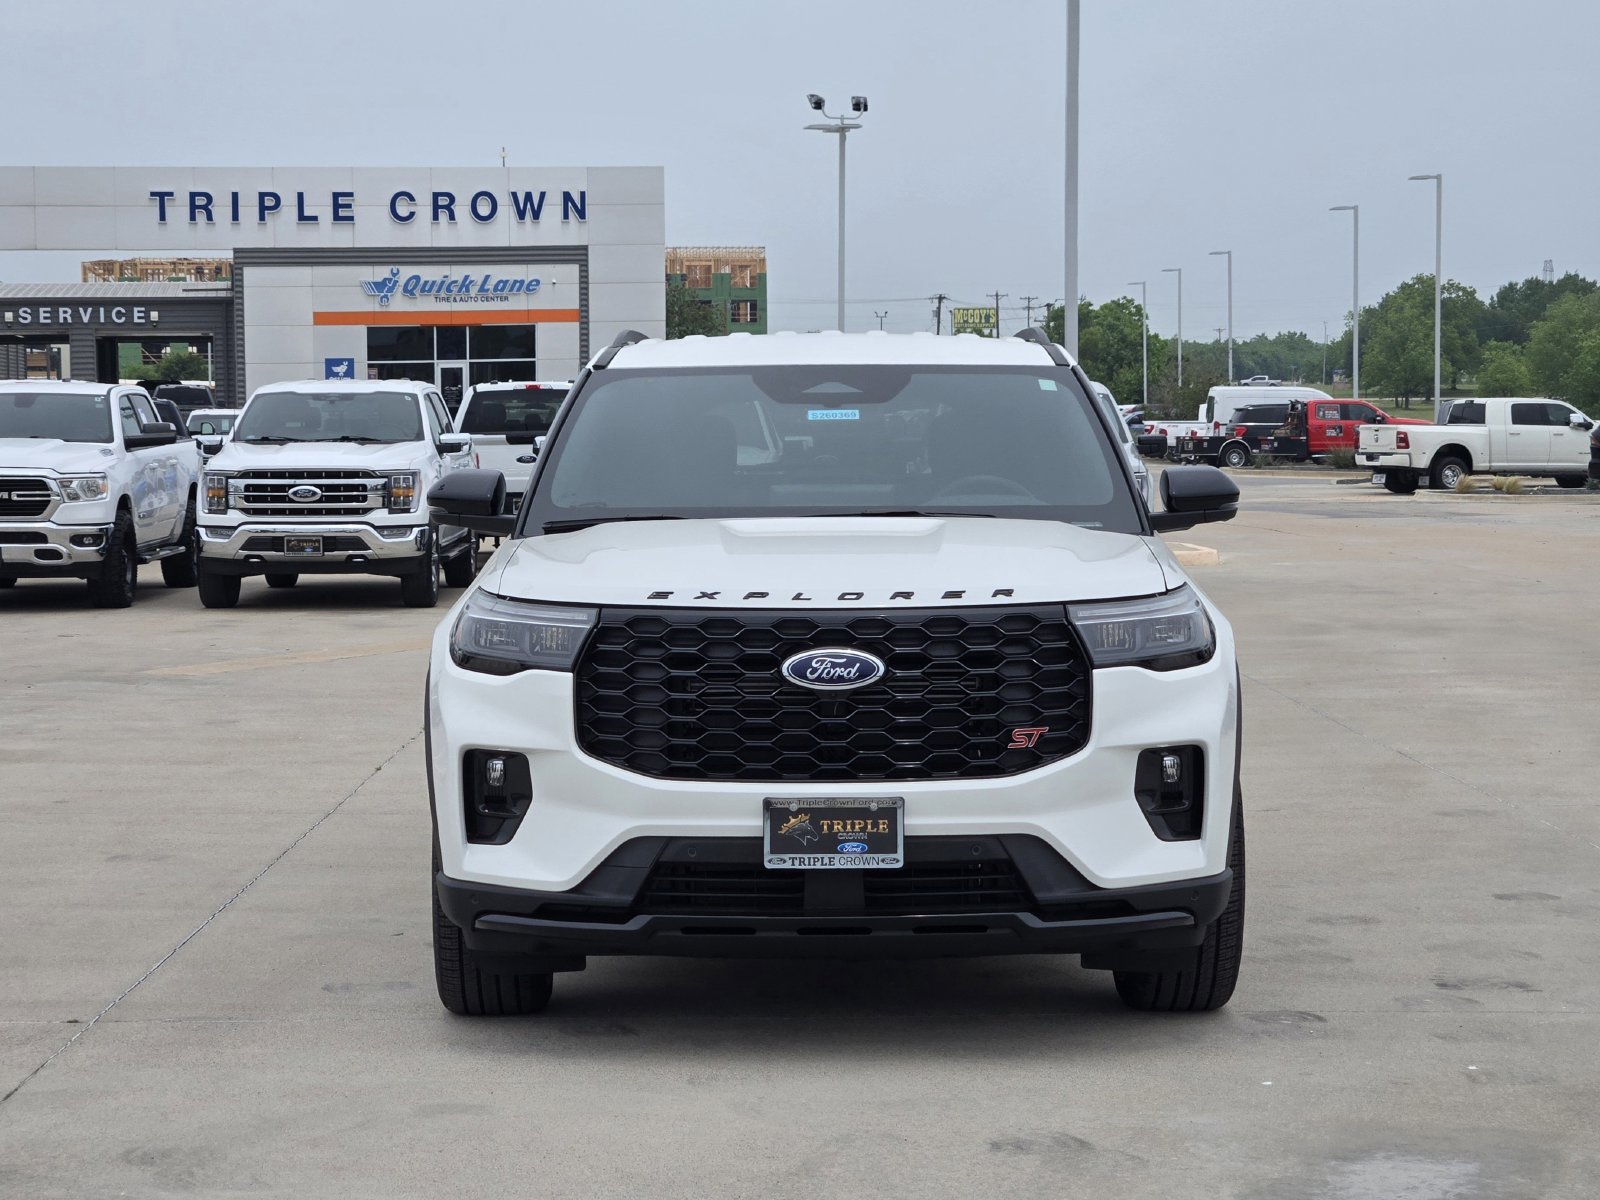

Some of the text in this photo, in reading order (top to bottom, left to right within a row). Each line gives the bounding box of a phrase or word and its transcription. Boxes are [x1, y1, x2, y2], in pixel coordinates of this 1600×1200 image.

[149, 190, 588, 224] TRIPLE CROWN
[401, 274, 541, 298] Quick Lane
[18, 306, 146, 324] SERVICE
[647, 588, 1015, 601] EXPLORER
[1007, 726, 1049, 749] ST
[820, 819, 889, 834] TRIPLE
[788, 856, 836, 867] TRIPLE
[838, 856, 880, 866] CROWN
